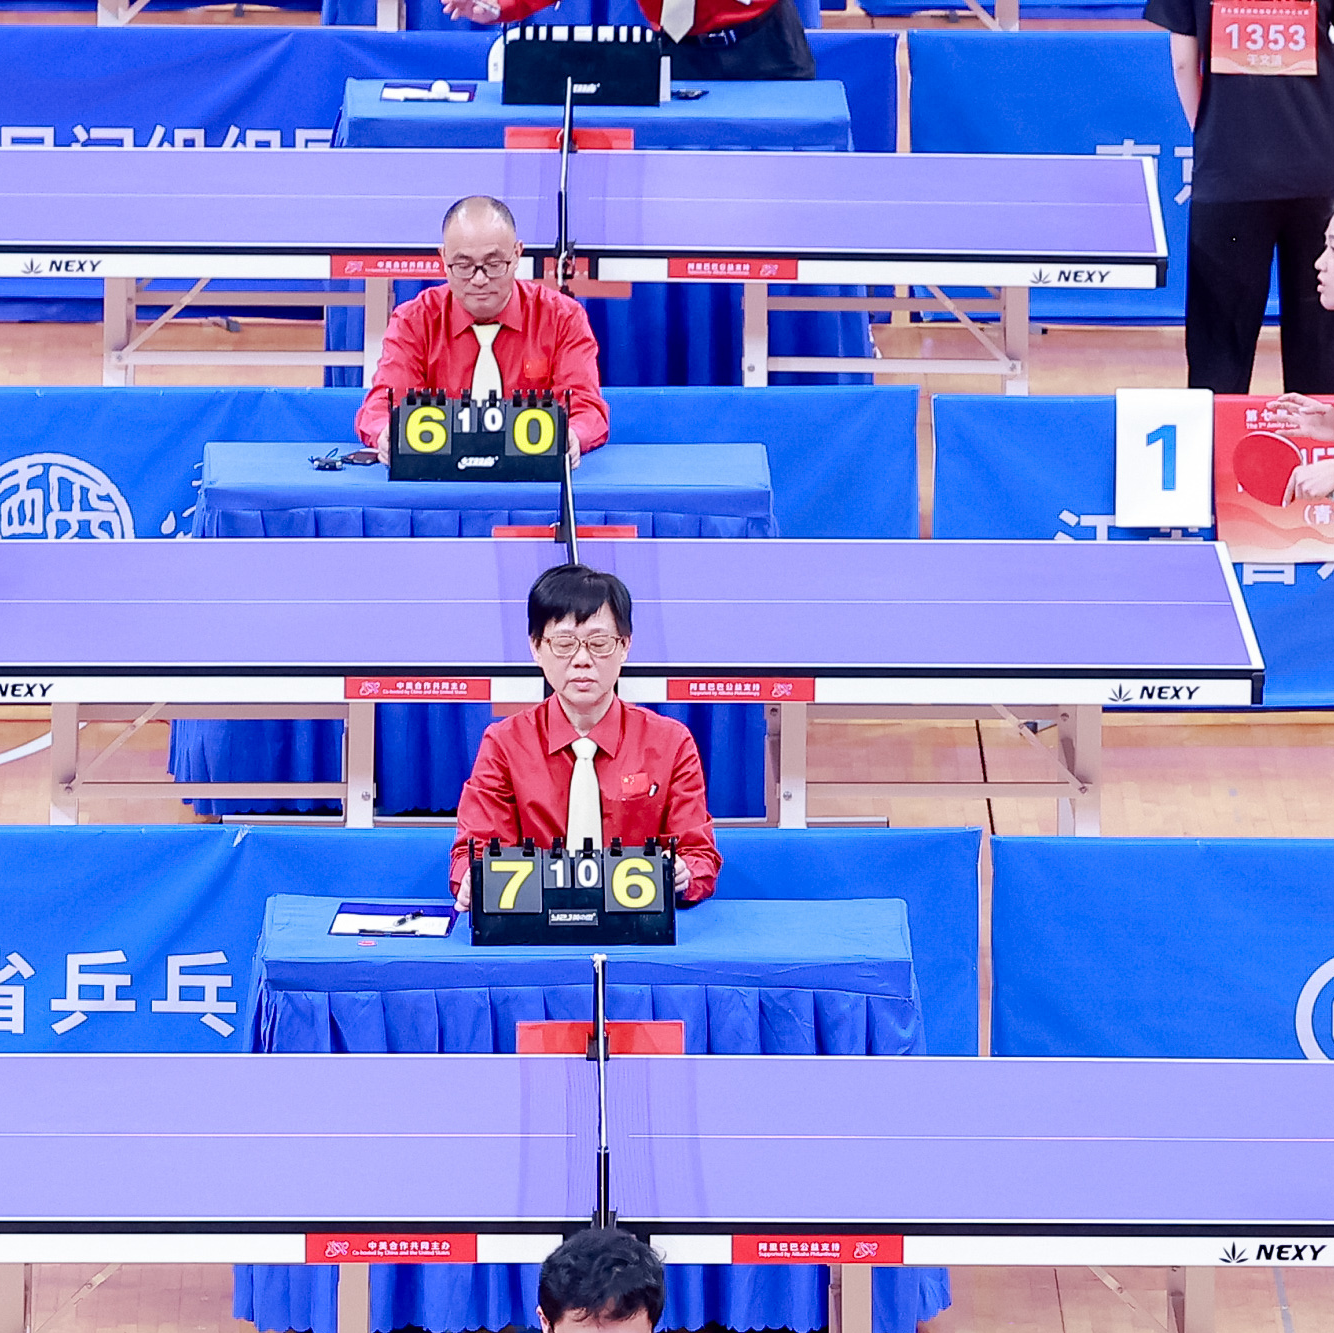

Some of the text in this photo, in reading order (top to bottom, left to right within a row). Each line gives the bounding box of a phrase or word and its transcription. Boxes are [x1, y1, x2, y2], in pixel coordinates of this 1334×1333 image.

[1225, 23, 1307, 51] 1353
[48, 259, 104, 274] NEXY
[1057, 269, 1111, 284] NEXY
[406, 406, 555, 455] 6 1 0 0
[1145, 425, 1177, 491] 1
[1139, 685, 1200, 701] NEXY
[490, 857, 657, 910] 7 1 0 6
[758, 1242, 840, 1251] 阿里巴巴公益支持
[1255, 1243, 1326, 1261] NEXY
